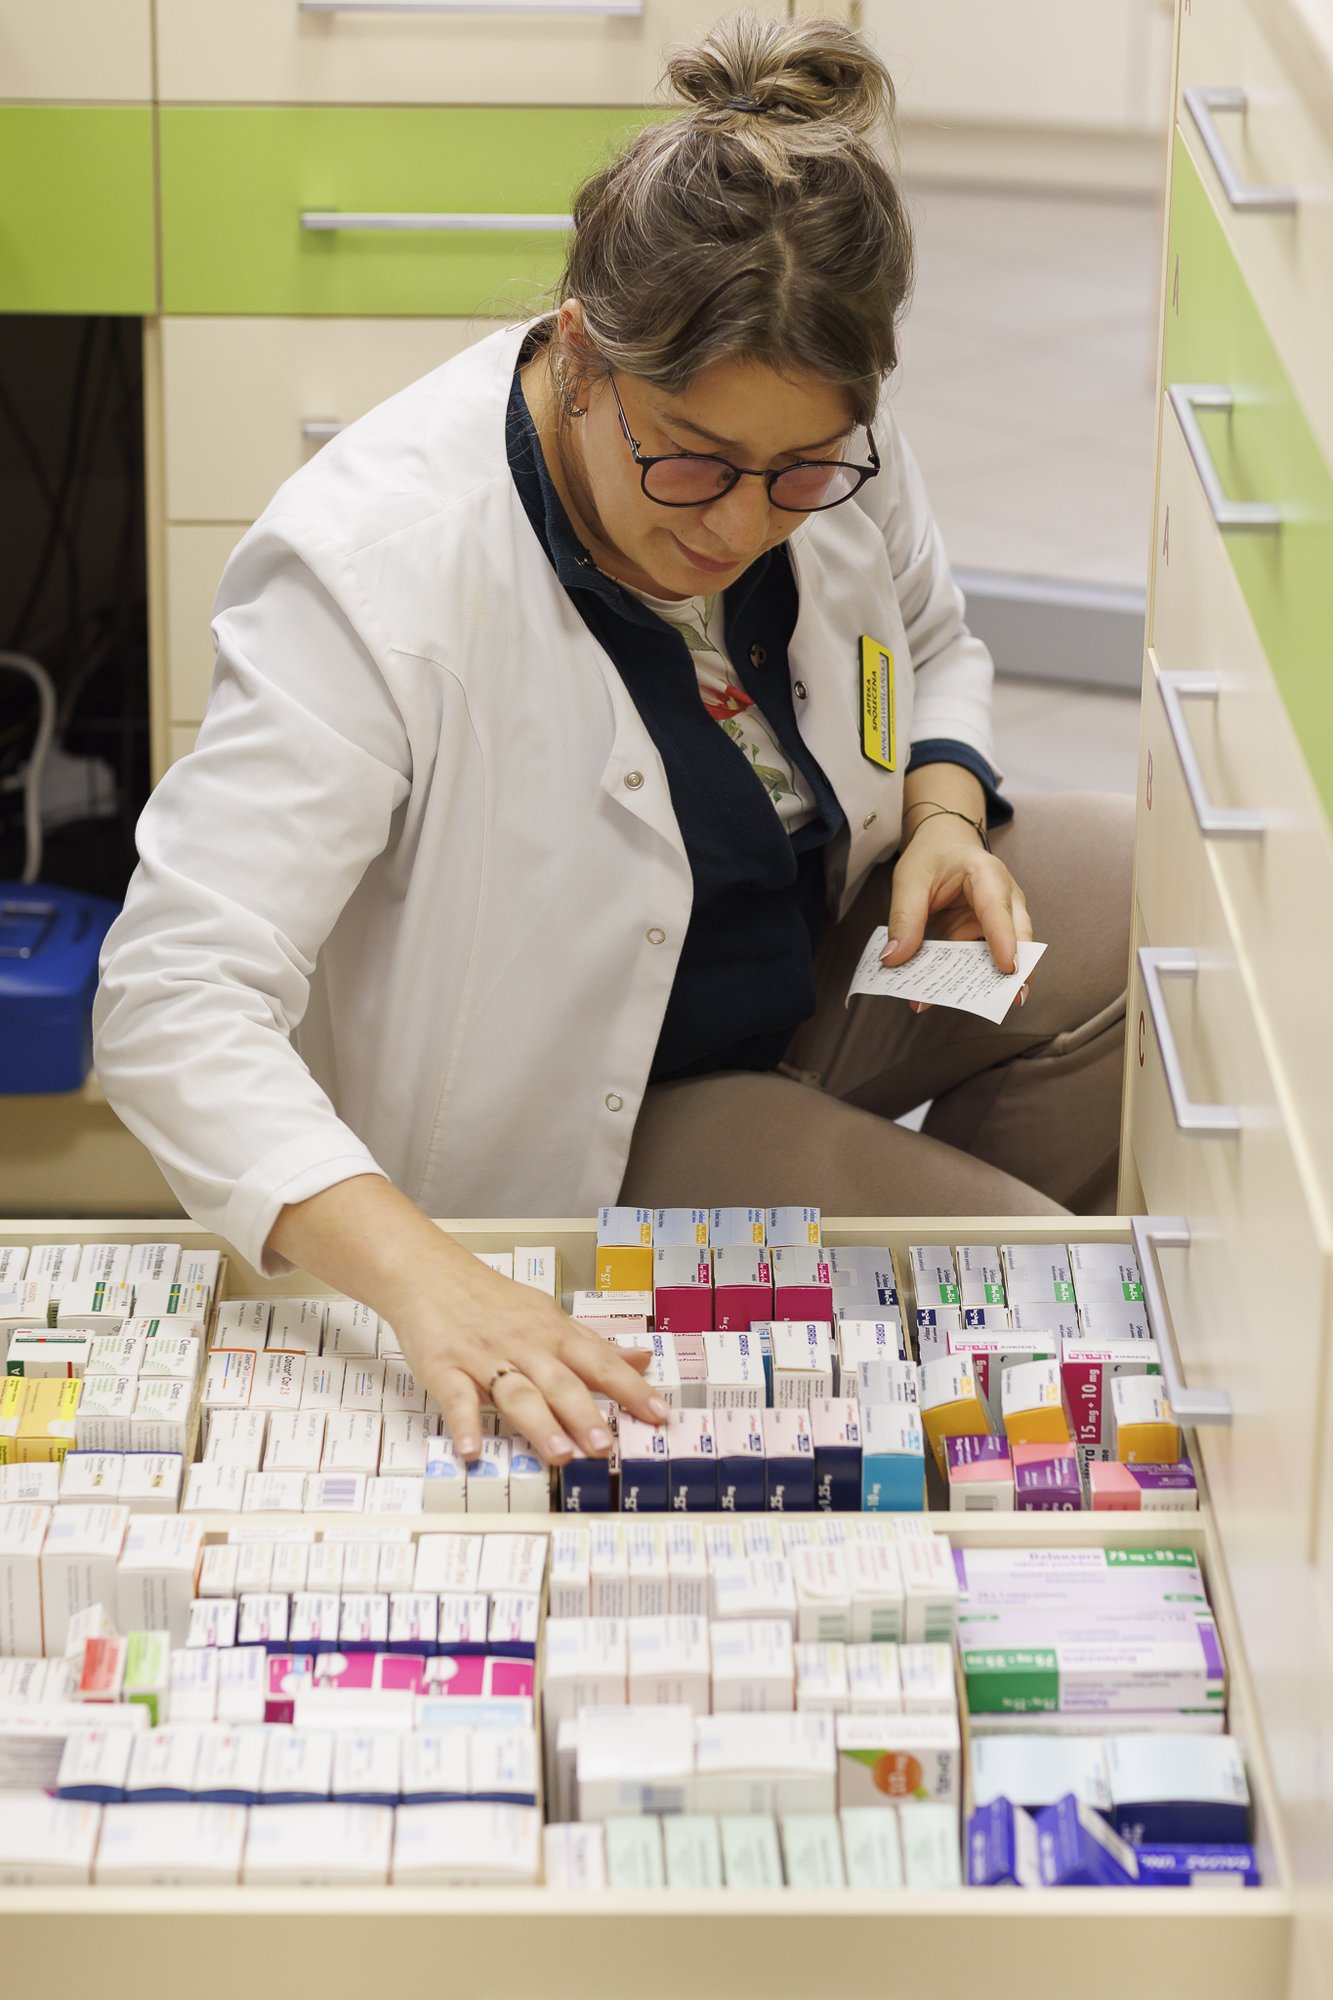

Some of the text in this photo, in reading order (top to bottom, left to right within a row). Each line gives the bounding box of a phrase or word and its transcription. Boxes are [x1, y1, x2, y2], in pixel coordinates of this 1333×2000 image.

[1138, 1010, 1146, 1068] C
[600, 1272, 611, 1289] 1,25
[806, 1324, 818, 1346] CIRRUS
[875, 1323, 886, 1345] CIRRUS
[652, 1335, 665, 1357] CIRRUS
[738, 1334, 749, 1356] CIRRUS
[282, 1355, 295, 1376] Concor
[1089, 1369, 1100, 1382] mg
[1081, 1383, 1097, 1399] 10
[1088, 1408, 1099, 1423] mg
[1081, 1424, 1096, 1439] 15
[1109, 1551, 1127, 1563] 75
[1129, 1554, 1146, 1564] mg
[1156, 1551, 1174, 1562] 25
[1176, 1553, 1193, 1563] mg
